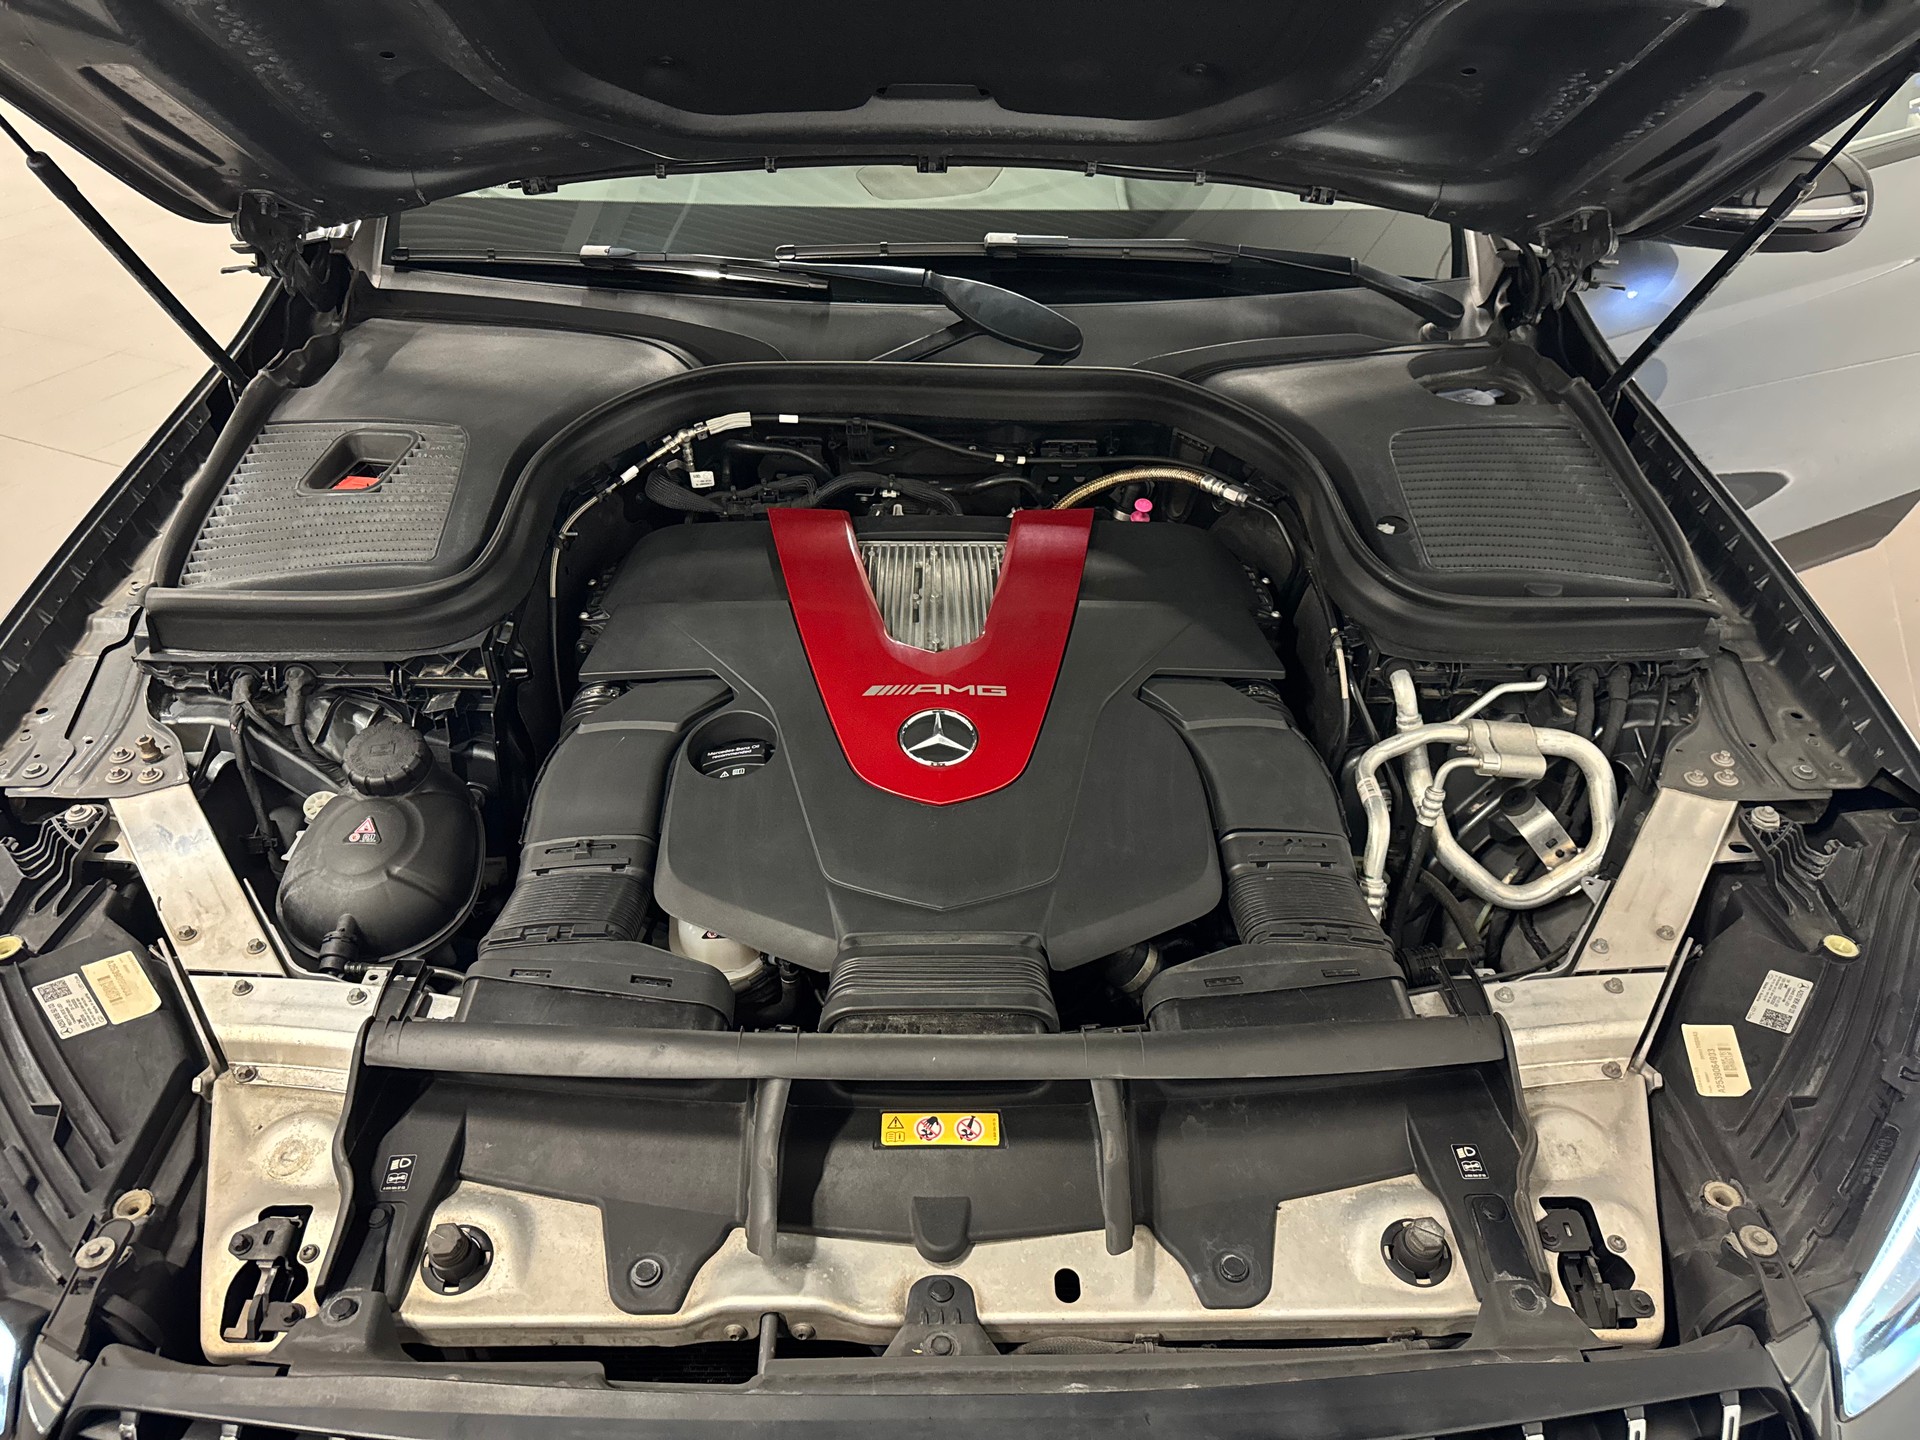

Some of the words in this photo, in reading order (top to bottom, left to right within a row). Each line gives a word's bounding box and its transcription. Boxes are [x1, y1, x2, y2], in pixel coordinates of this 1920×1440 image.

[908, 683, 1008, 697] AMG
[707, 745, 751, 757] Mercedes-Benz
[711, 749, 753, 760] recommended
